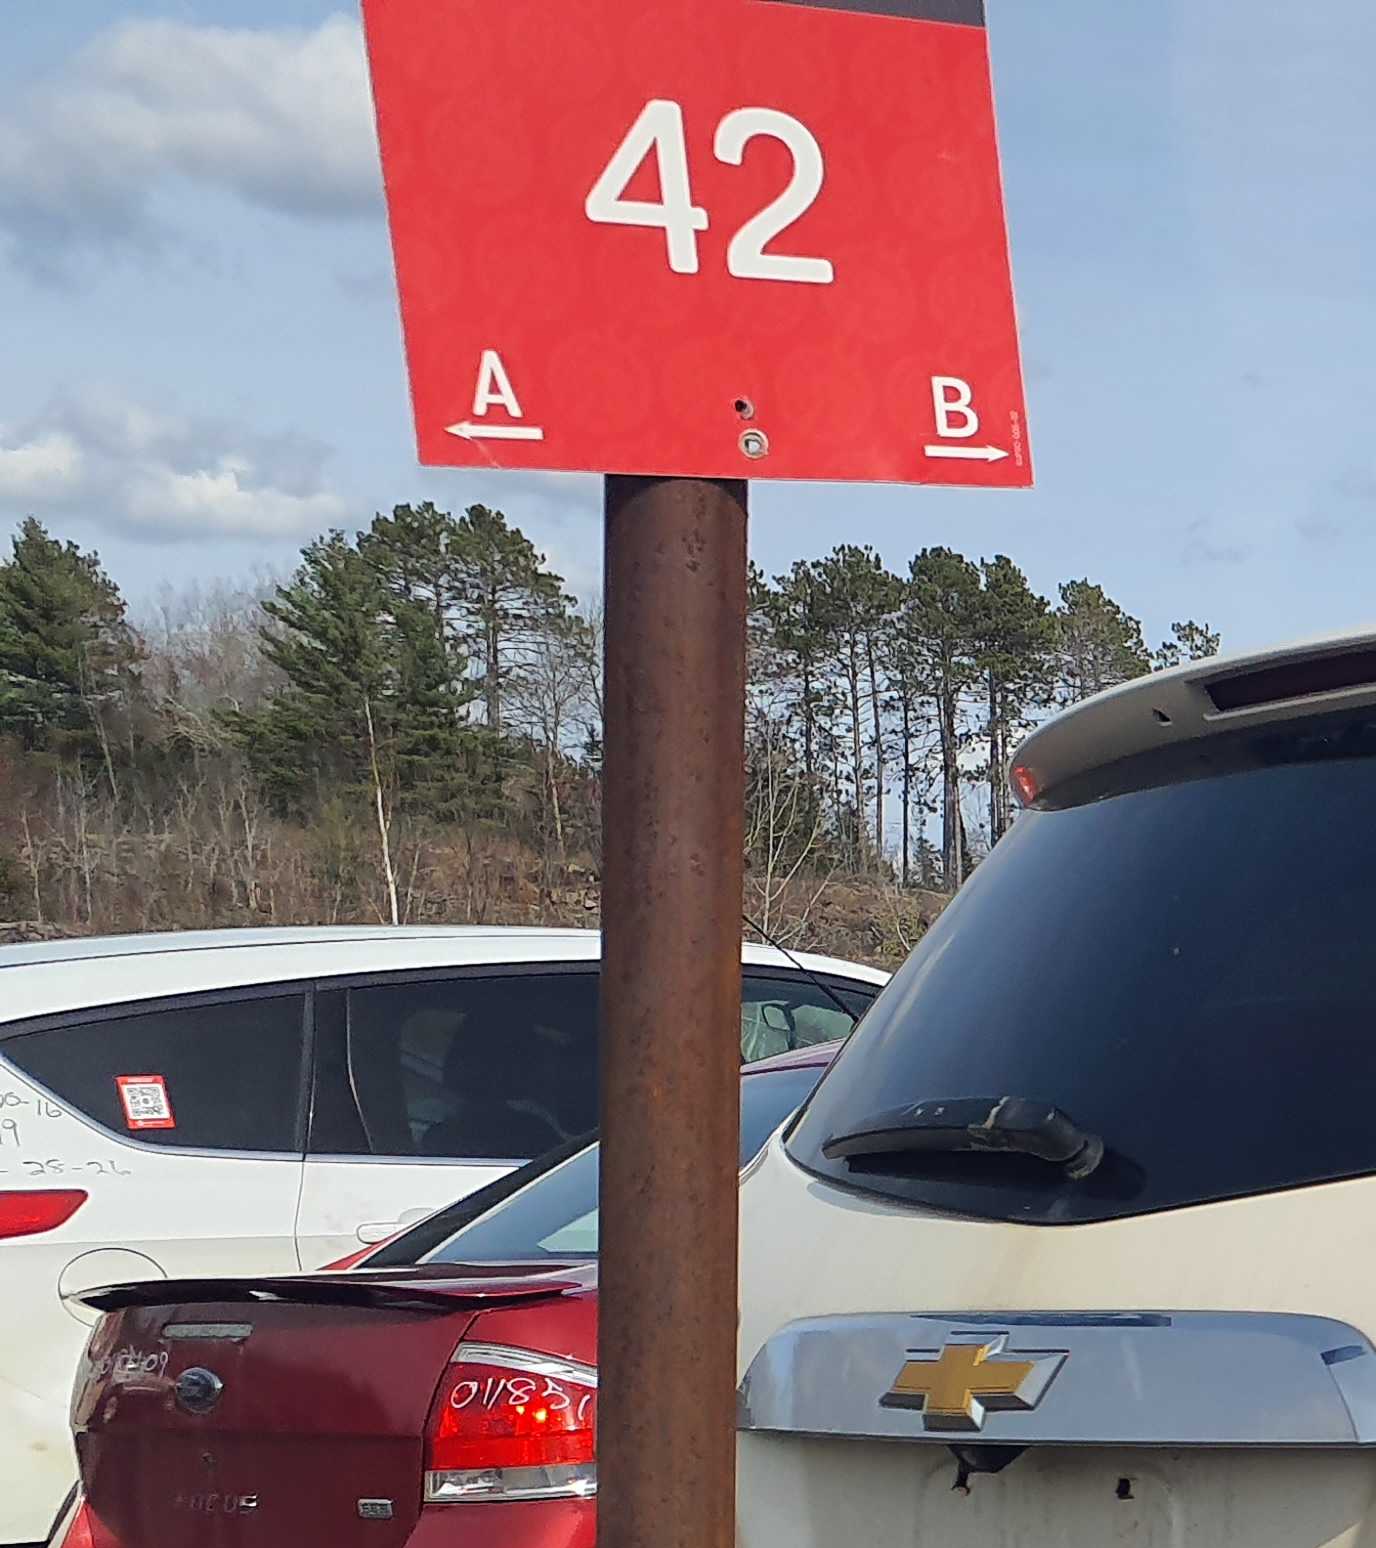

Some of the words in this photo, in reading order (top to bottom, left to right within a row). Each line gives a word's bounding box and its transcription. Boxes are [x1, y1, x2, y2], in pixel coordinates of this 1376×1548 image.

[585, 99, 834, 284] 42
[472, 350, 522, 418] A
[930, 376, 980, 438] B
